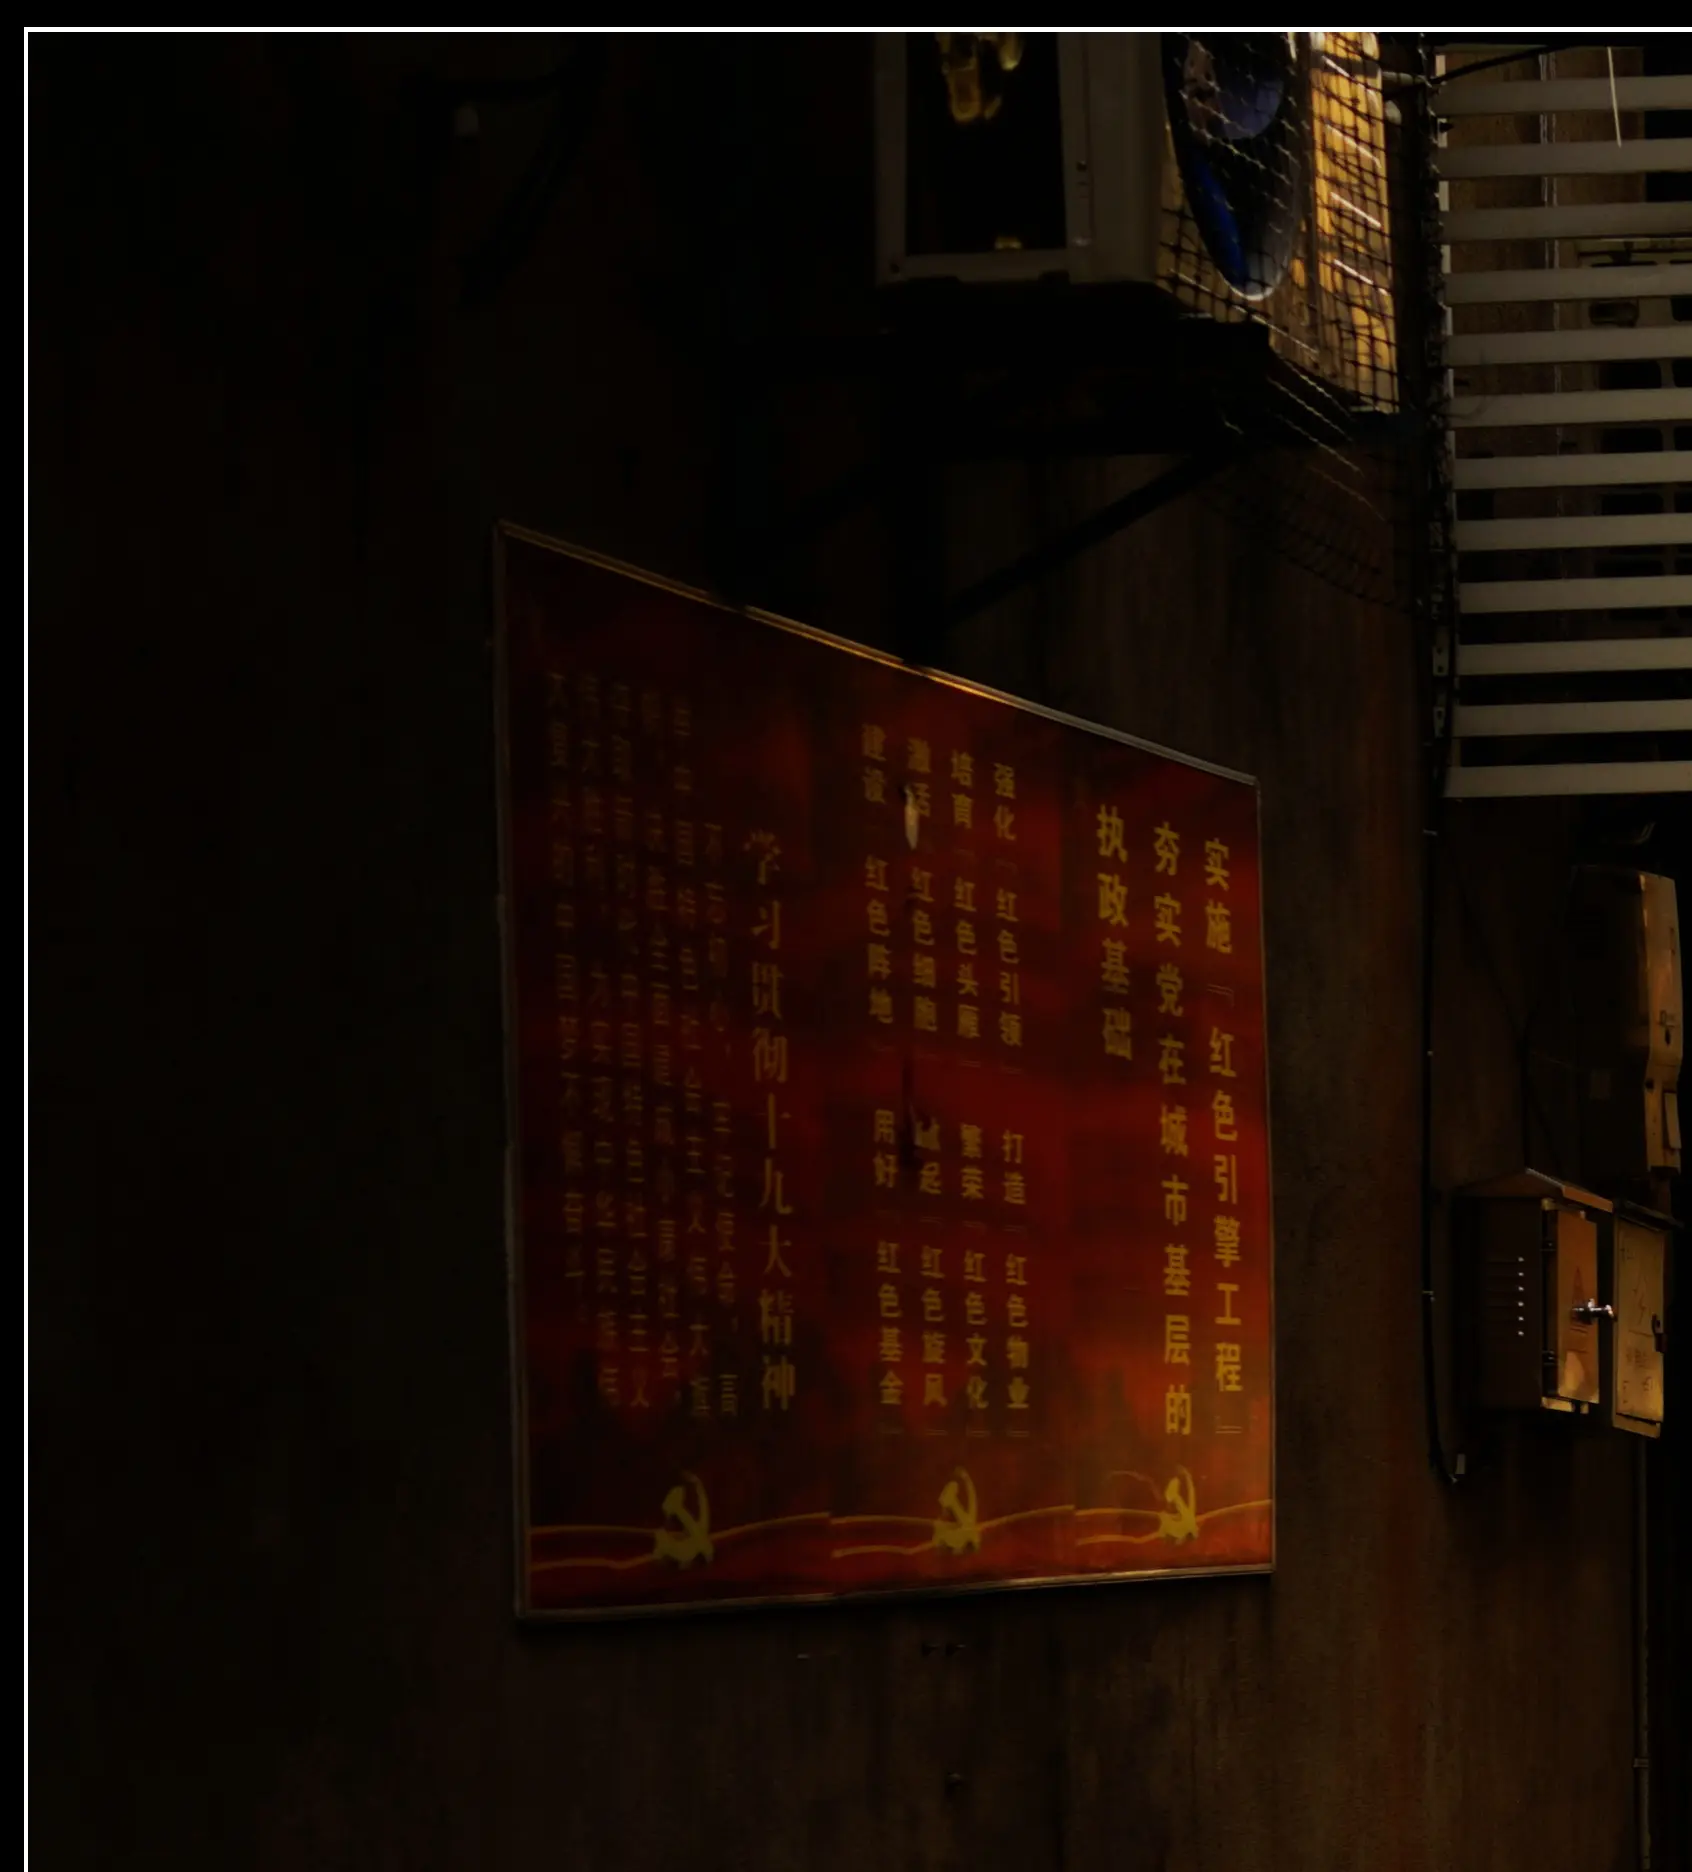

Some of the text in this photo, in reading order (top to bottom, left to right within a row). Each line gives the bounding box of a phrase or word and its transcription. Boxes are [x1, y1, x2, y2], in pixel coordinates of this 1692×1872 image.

[743, 827, 796, 1412] 学习贯彻十九大精神
[1096, 804, 1133, 1062] 执政基础
[1153, 820, 1193, 1436] 夯实党在城市基层的
